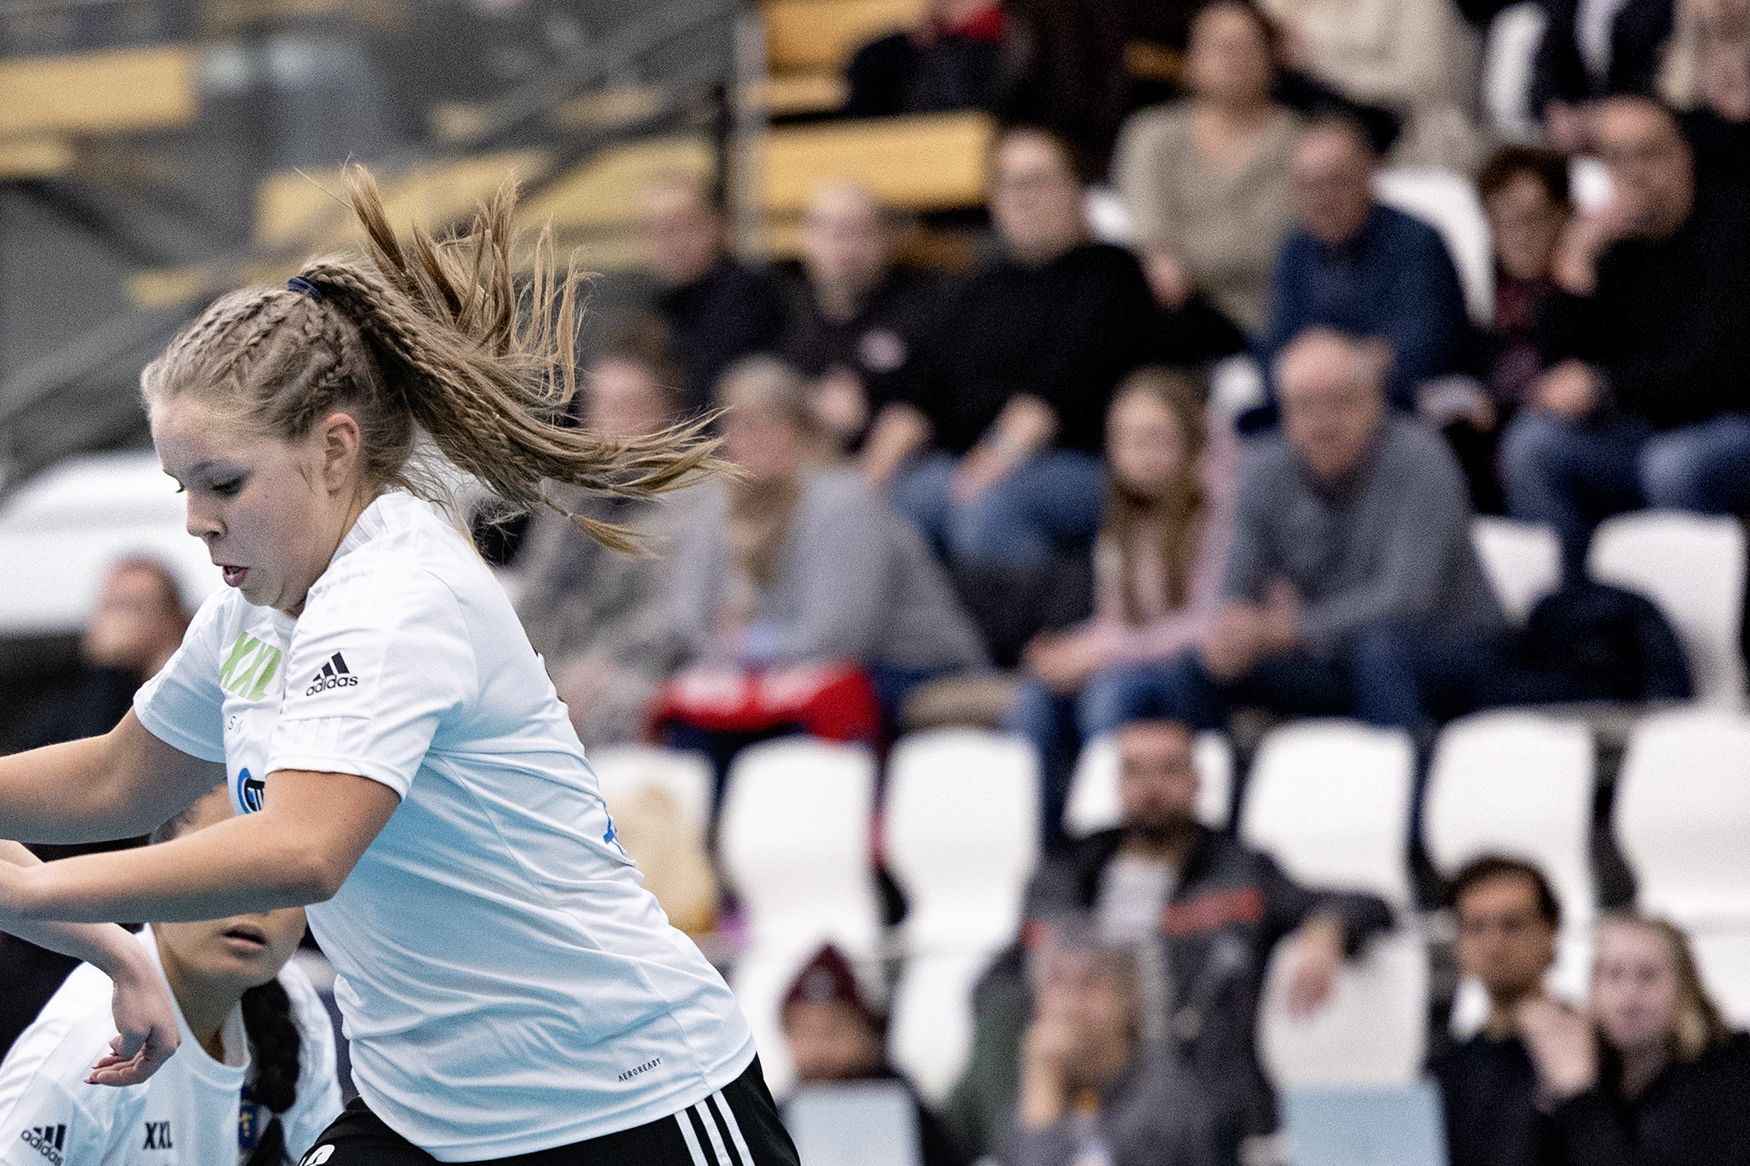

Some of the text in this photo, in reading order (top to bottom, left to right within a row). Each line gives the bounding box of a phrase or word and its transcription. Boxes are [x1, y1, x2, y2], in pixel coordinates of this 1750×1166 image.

[221, 632, 282, 702] XXL
[305, 675, 358, 697] adidas
[618, 1058, 661, 1082] AEROREADY
[21, 1129, 64, 1166] adidas
[142, 1120, 173, 1150] XXL
